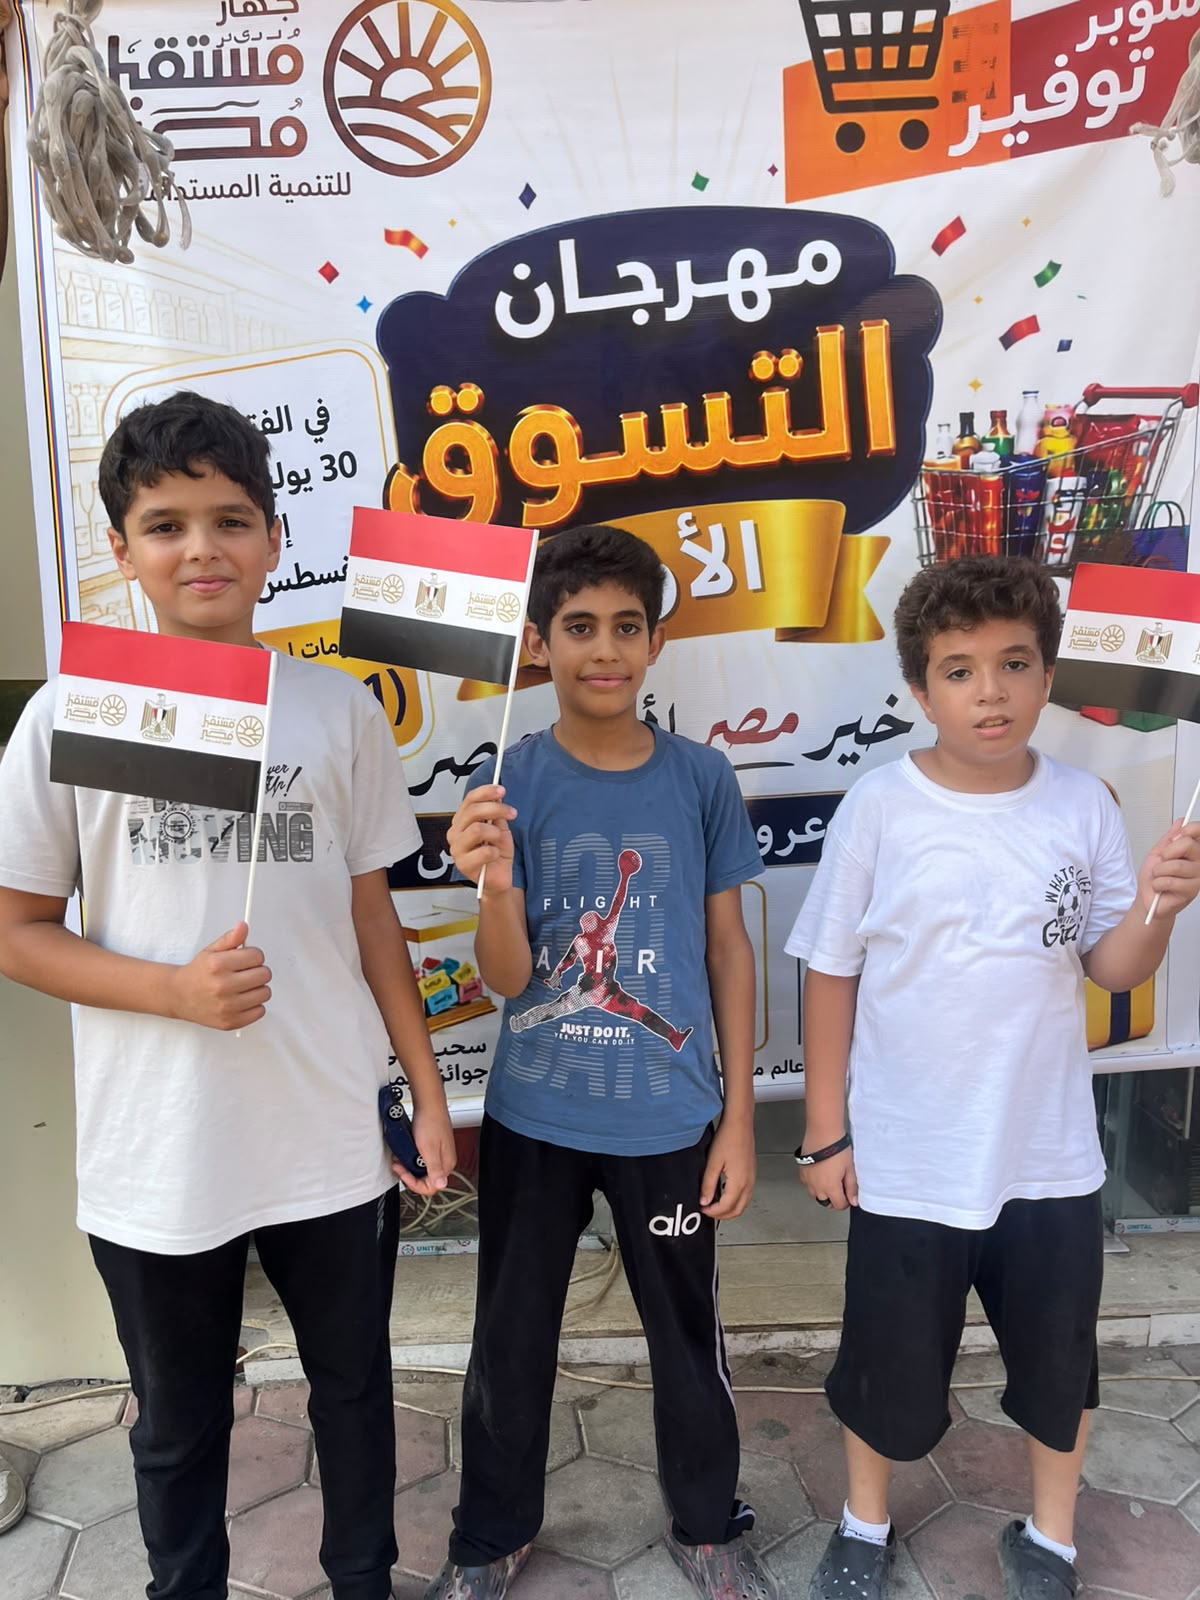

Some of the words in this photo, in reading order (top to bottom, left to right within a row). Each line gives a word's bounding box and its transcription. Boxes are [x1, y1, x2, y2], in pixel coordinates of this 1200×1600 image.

[948, 46, 1155, 158] توفير
[151, 98, 308, 162] مص
[268, 171, 351, 204] للتنمية
[494, 238, 842, 340] مهرجان
[304, 397, 331, 444] في
[383, 318, 897, 530] التسوق
[319, 450, 358, 482] 30
[705, 707, 800, 750] مصر
[801, 693, 915, 767] خير
[756, 816, 826, 857] عرو
[543, 894, 659, 911] FLIGHT
[536, 945, 658, 975] AIR
[554, 1031, 569, 1041] YES
[572, 1035, 588, 1043] YOU
[591, 1038, 609, 1046] CAN
[612, 1038, 624, 1046] DO
[560, 1022, 591, 1037] JUST
[593, 1026, 614, 1039] DO
[614, 1026, 631, 1038] IT.
[648, 1203, 700, 1238] alo
